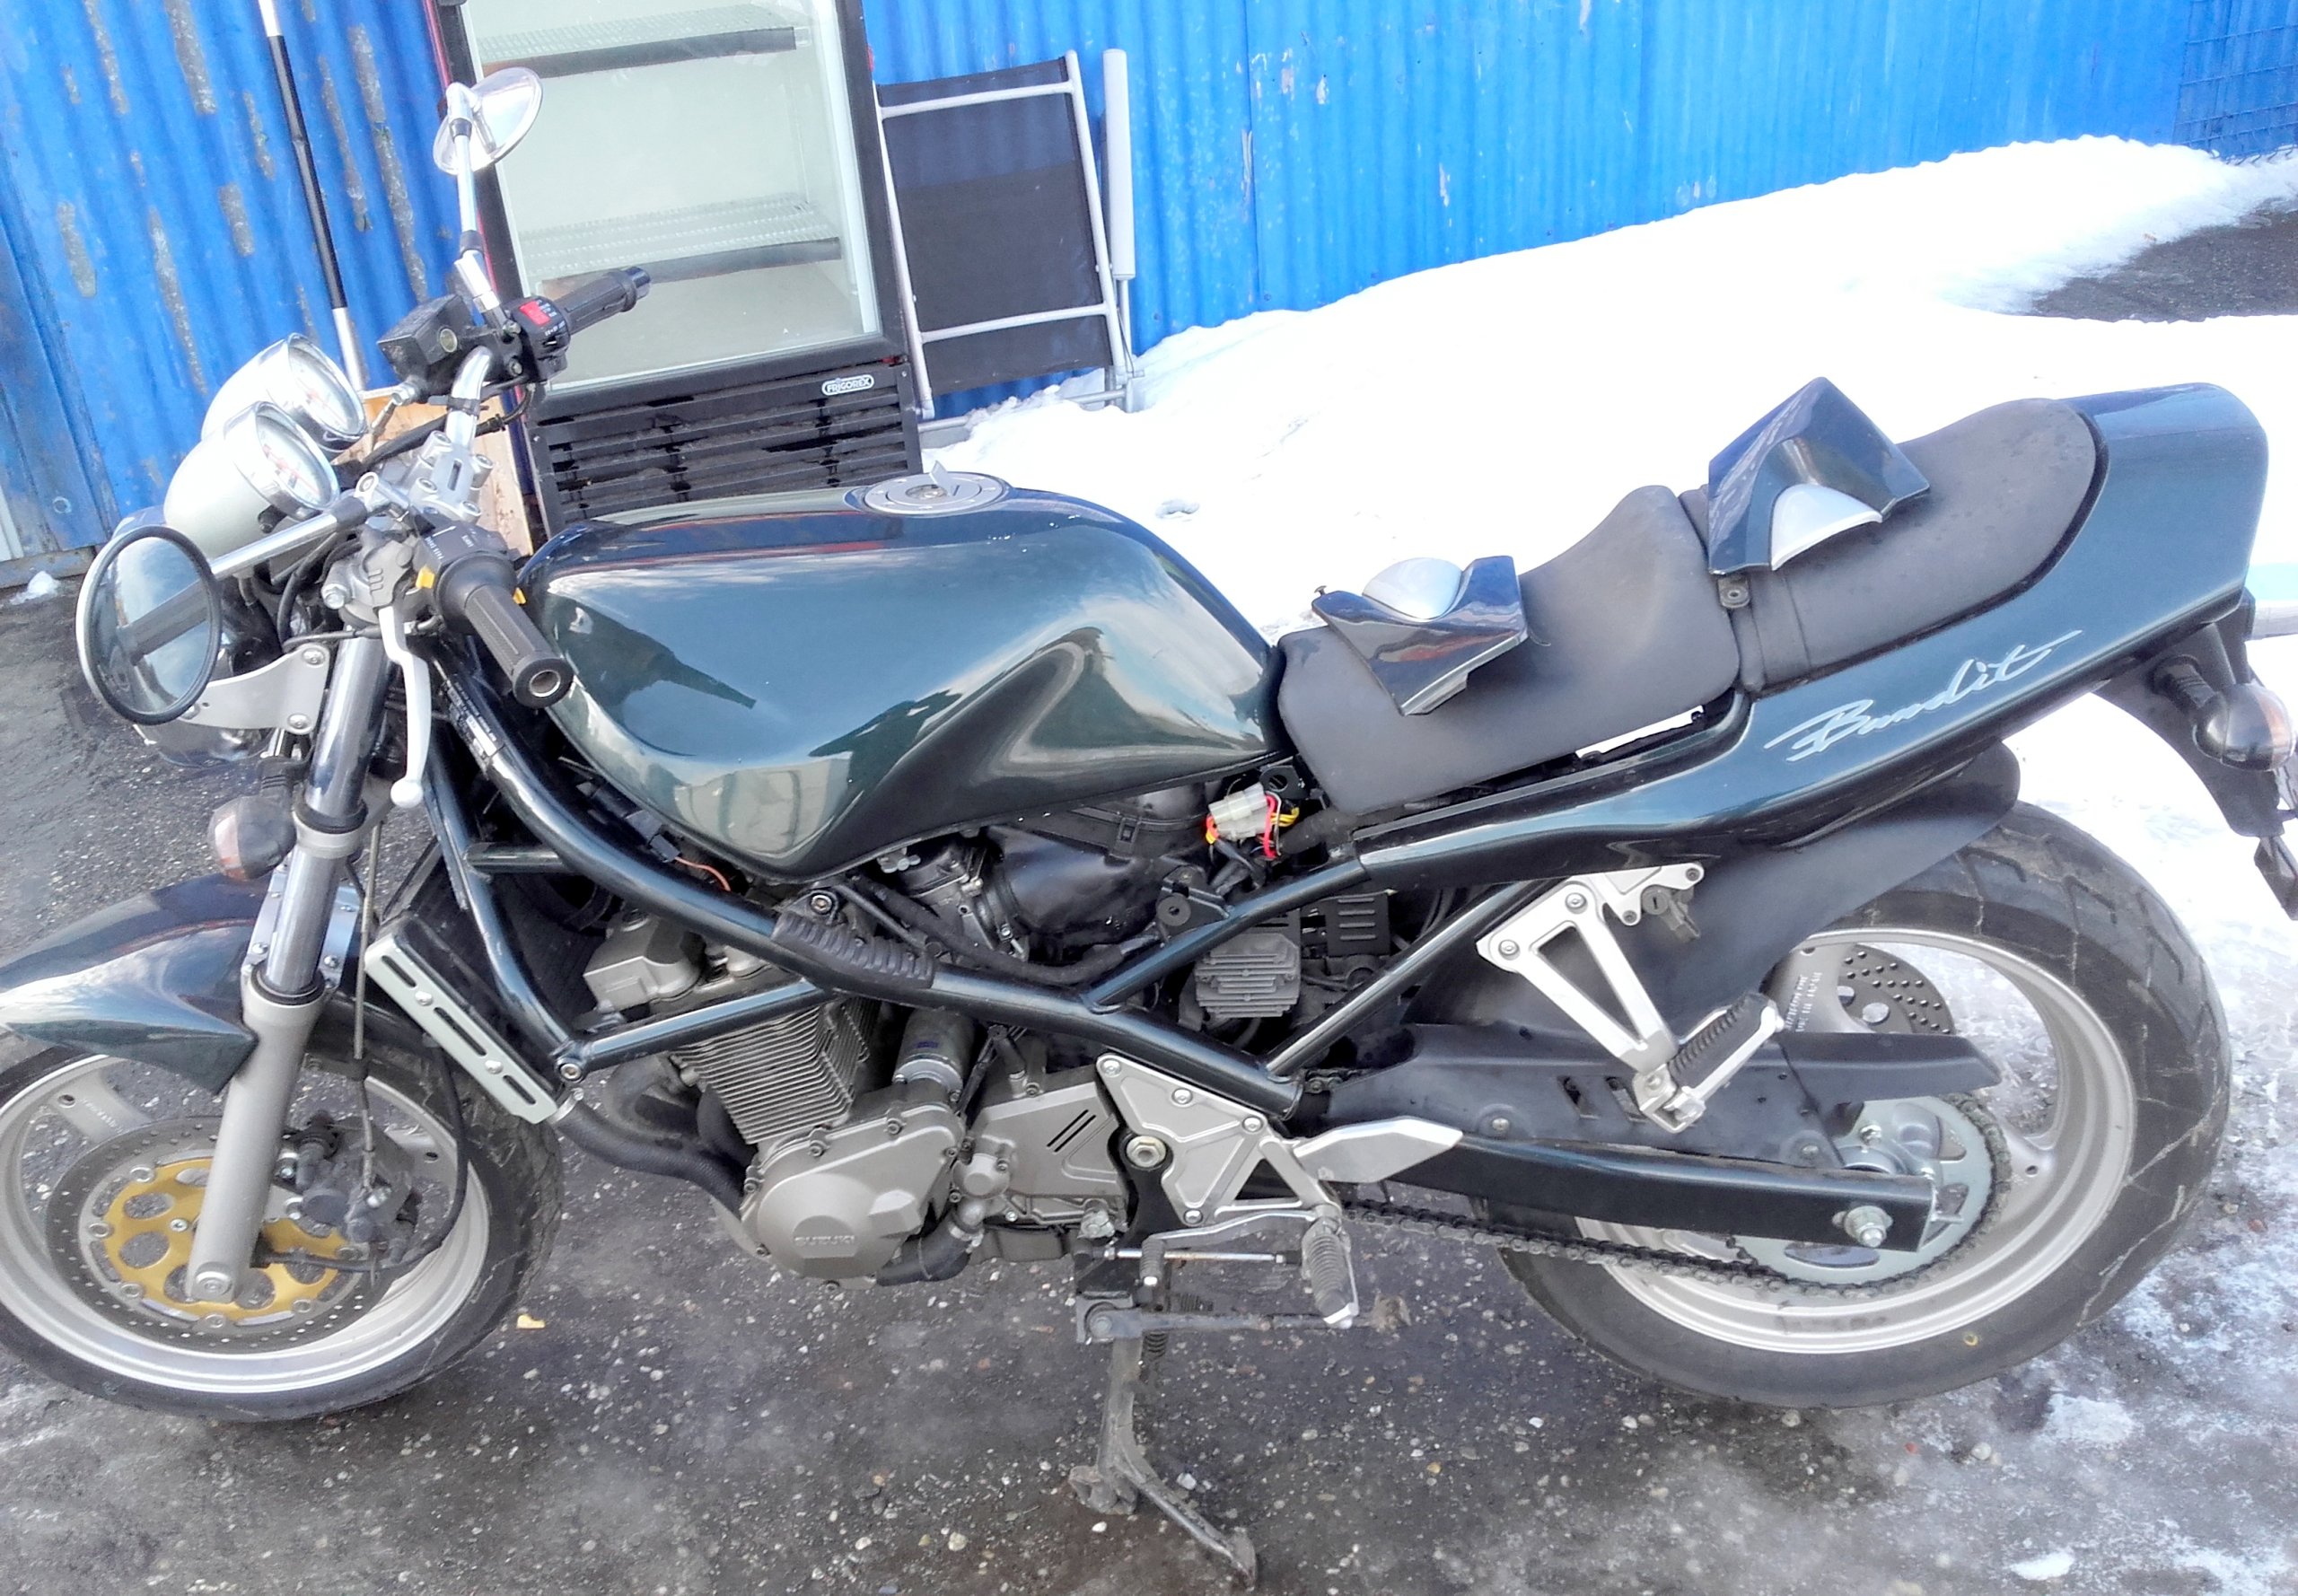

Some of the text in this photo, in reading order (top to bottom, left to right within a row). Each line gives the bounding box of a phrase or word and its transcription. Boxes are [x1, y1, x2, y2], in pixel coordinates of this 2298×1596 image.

[826, 377, 871, 393] FRIGOREX
[1763, 629, 2083, 762] Bandit
[794, 1234, 855, 1247] SUZUKI
